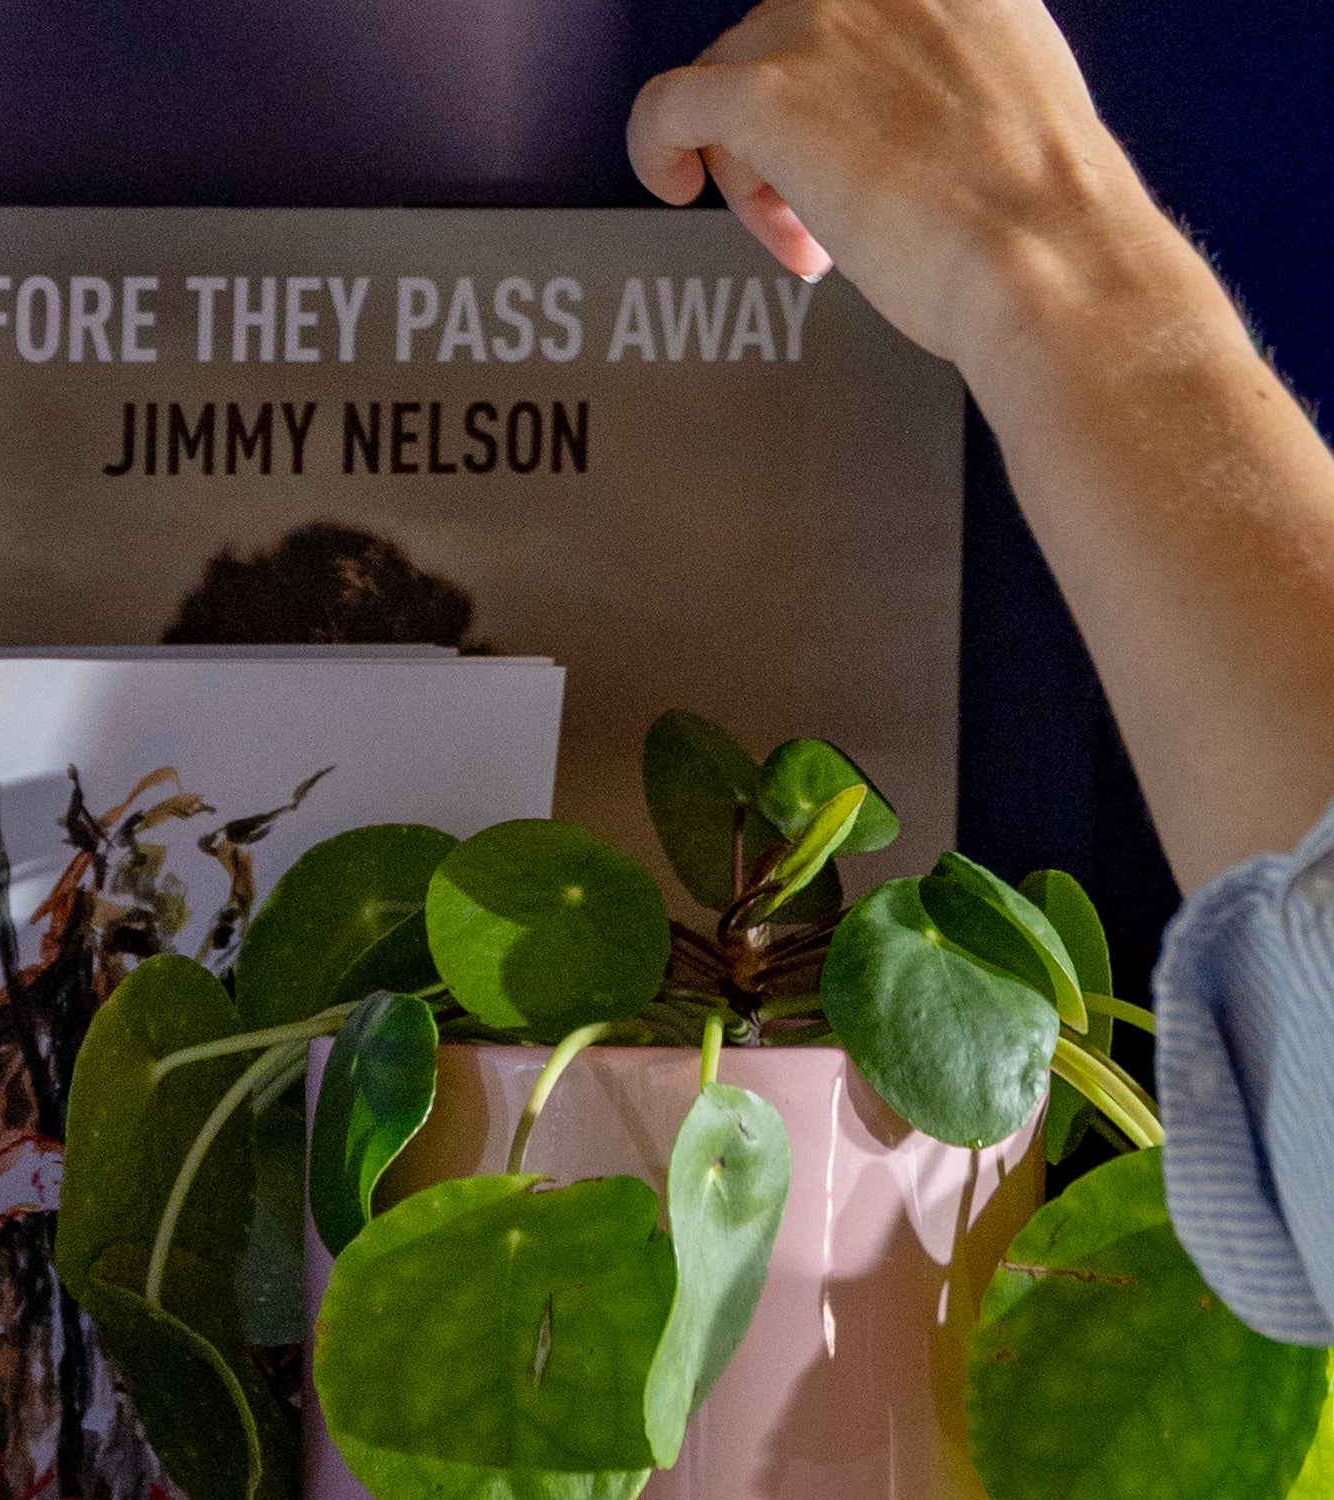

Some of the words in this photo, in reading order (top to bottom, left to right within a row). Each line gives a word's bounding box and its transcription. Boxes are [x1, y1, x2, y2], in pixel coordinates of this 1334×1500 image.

[185, 275, 371, 364] THEY
[395, 274, 585, 364] PASS
[606, 275, 816, 364] AWAY
[102, 401, 318, 476] JIMMY
[342, 400, 589, 475] NELSON
